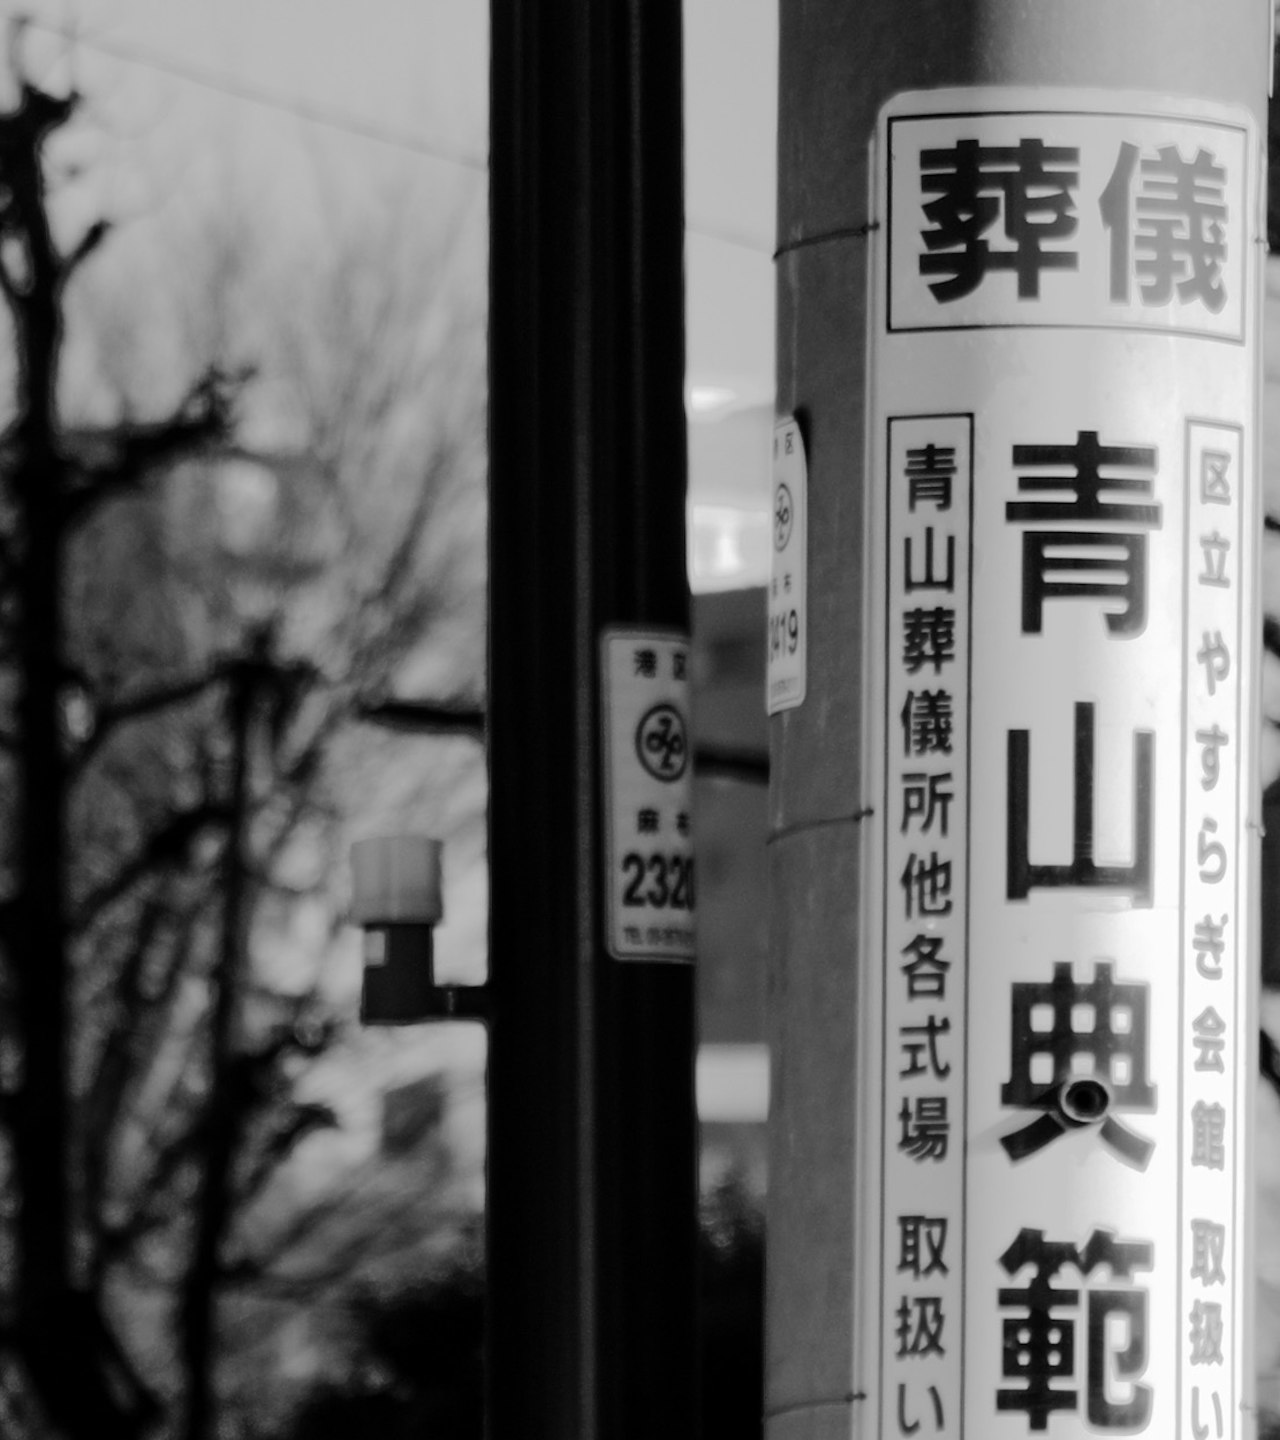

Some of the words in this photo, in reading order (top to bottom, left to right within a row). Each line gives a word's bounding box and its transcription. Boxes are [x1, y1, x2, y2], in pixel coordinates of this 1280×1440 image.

[919, 138, 1228, 315] 葬儀
[898, 443, 957, 1163] 青山葬儀所他各式場
[995, 430, 1162, 1435] 青山典範
[1191, 448, 1231, 1171] 区立やすらぎ会館
[895, 1215, 949, 1434] 取扱い
